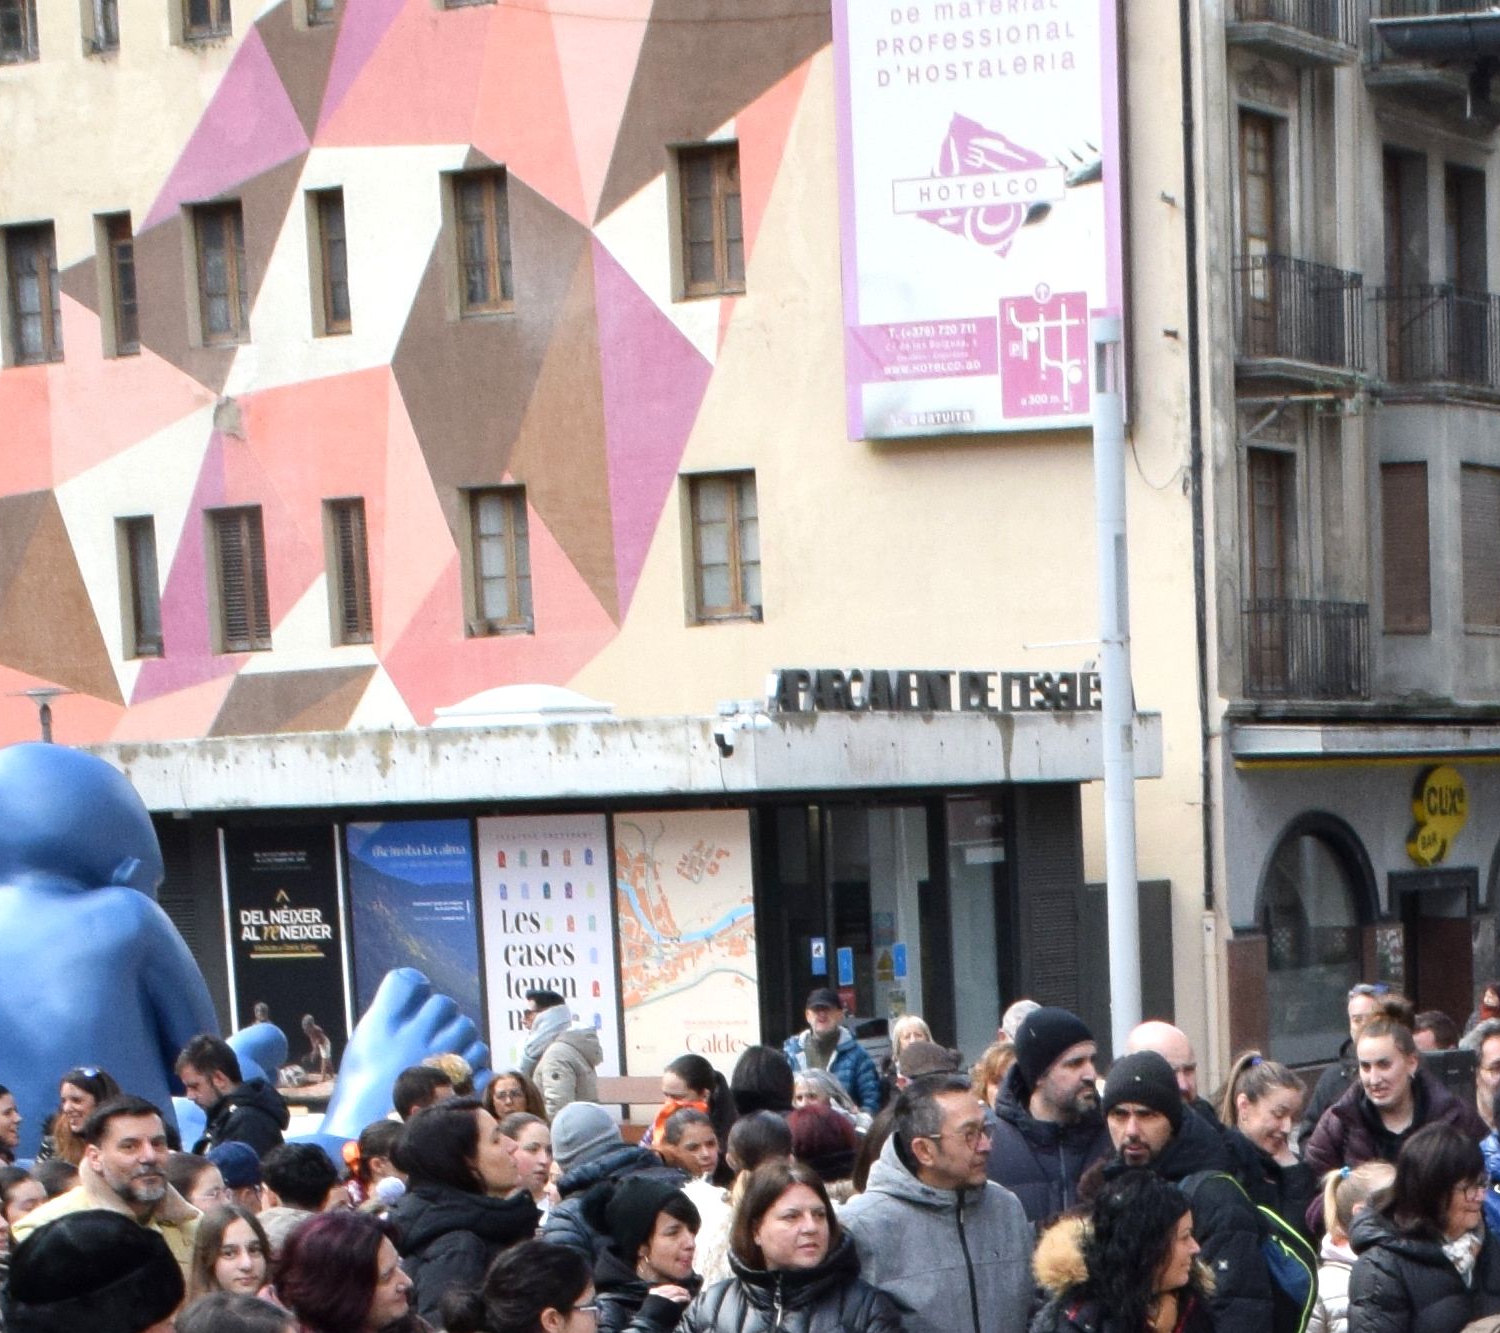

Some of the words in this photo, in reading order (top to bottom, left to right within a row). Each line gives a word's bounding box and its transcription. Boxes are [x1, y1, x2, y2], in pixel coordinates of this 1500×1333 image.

[240, 909, 269, 926] DEL
[501, 908, 542, 935] Les
[242, 926, 261, 941] AL
[503, 941, 575, 967] cases
[505, 970, 577, 1000] tenen
